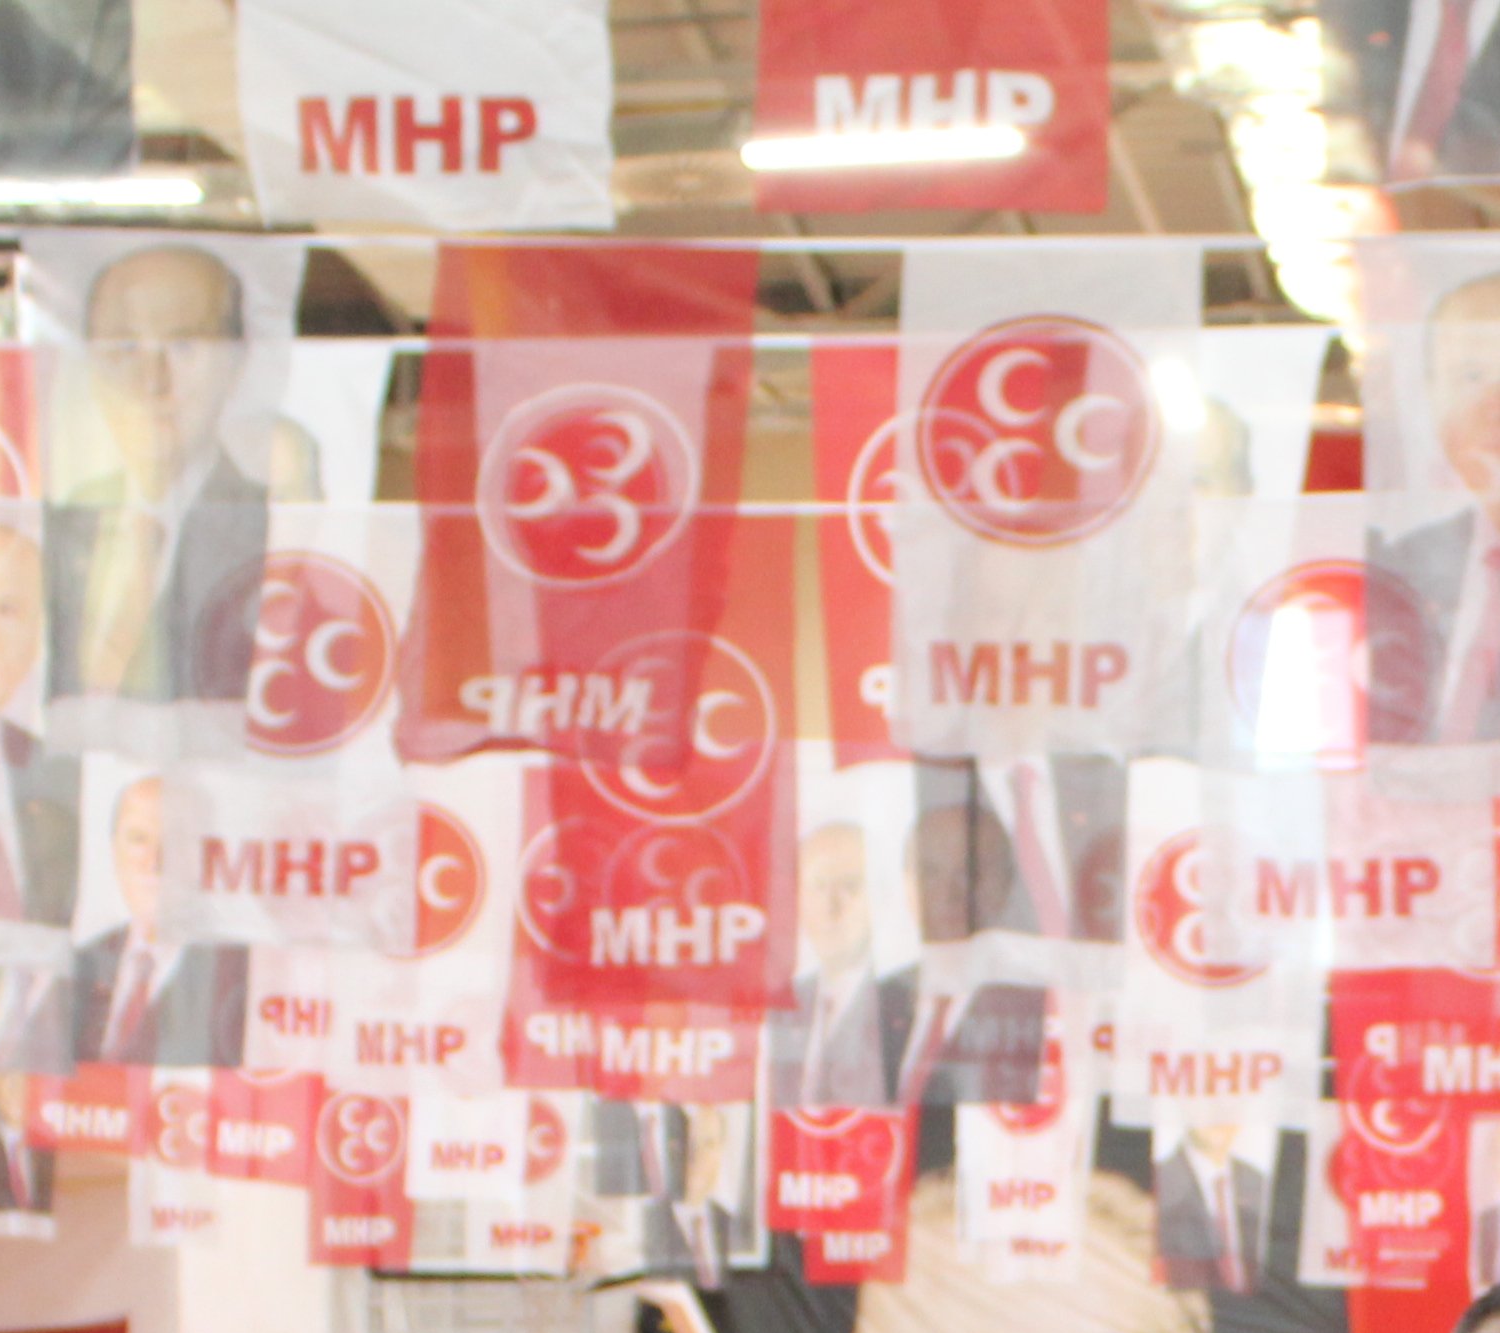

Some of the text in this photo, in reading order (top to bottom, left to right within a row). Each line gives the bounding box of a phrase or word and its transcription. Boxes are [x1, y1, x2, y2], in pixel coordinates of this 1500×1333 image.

[815, 69, 1055, 132] MHP
[299, 95, 536, 174] MHP
[928, 641, 1128, 709] MHP
[201, 837, 380, 897] MHP
[1255, 857, 1440, 919] MHP
[591, 904, 767, 967] MHP
[356, 1021, 464, 1065] MHP
[602, 1022, 736, 1077] MHP
[1150, 1053, 1282, 1097] MHP
[431, 1142, 505, 1172] MHP
[779, 1172, 860, 1209] MHP
[989, 1180, 1056, 1210] MHP
[1359, 1192, 1443, 1227] MHP
[324, 1215, 395, 1249] MHP
[823, 1232, 892, 1263] MHP
